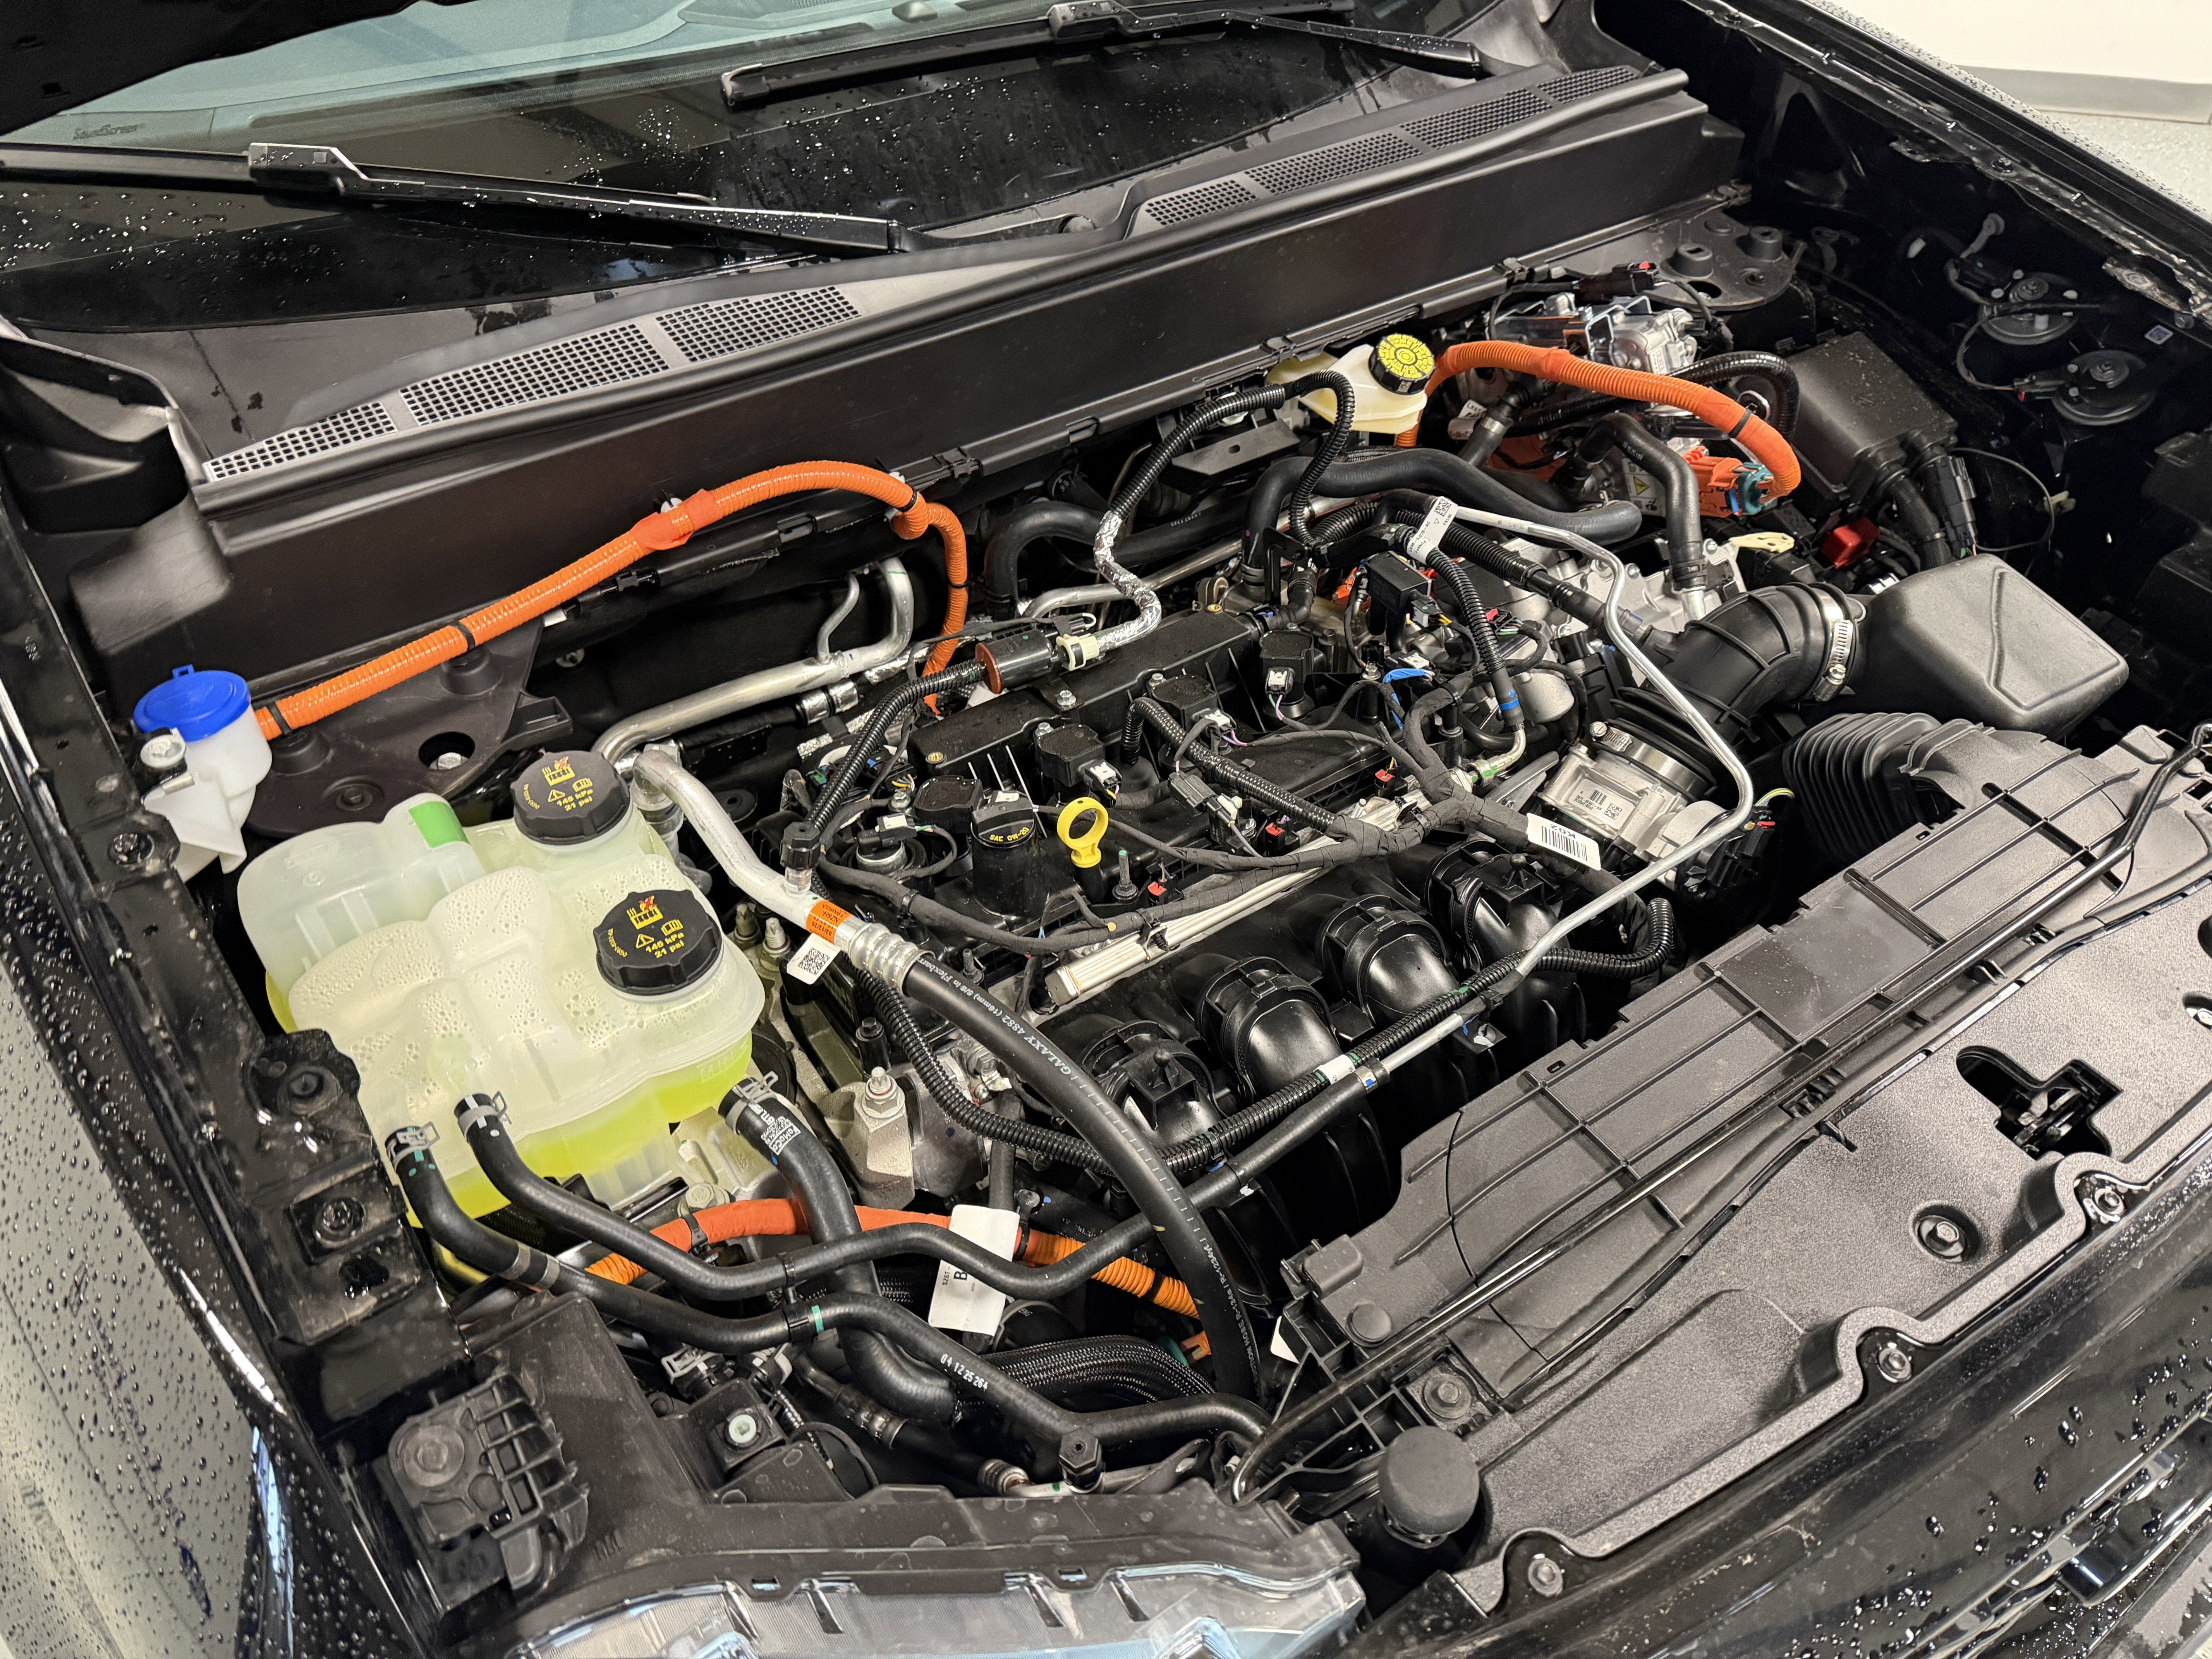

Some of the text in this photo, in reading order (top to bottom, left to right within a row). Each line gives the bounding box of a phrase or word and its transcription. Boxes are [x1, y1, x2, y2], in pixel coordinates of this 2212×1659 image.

[575, 789, 593, 800] kPa
[565, 796, 592, 811] 21 psi
[1007, 827, 1029, 841] 0W-20
[1551, 824, 1575, 839] K02
[646, 932, 684, 953] 145 kPa
[654, 940, 684, 958] 21 psi
[953, 979, 961, 988] in
[960, 985, 974, 996] 5/8
[973, 993, 1001, 1016] (16mm)
[1024, 1036, 1071, 1075] GALAXY
[772, 1127, 798, 1151] FoMoCo
[954, 1271, 967, 1281] B
[1238, 1319, 1250, 1345] HOSE
[954, 1362, 965, 1375] 12
[963, 1369, 975, 1382] 25
